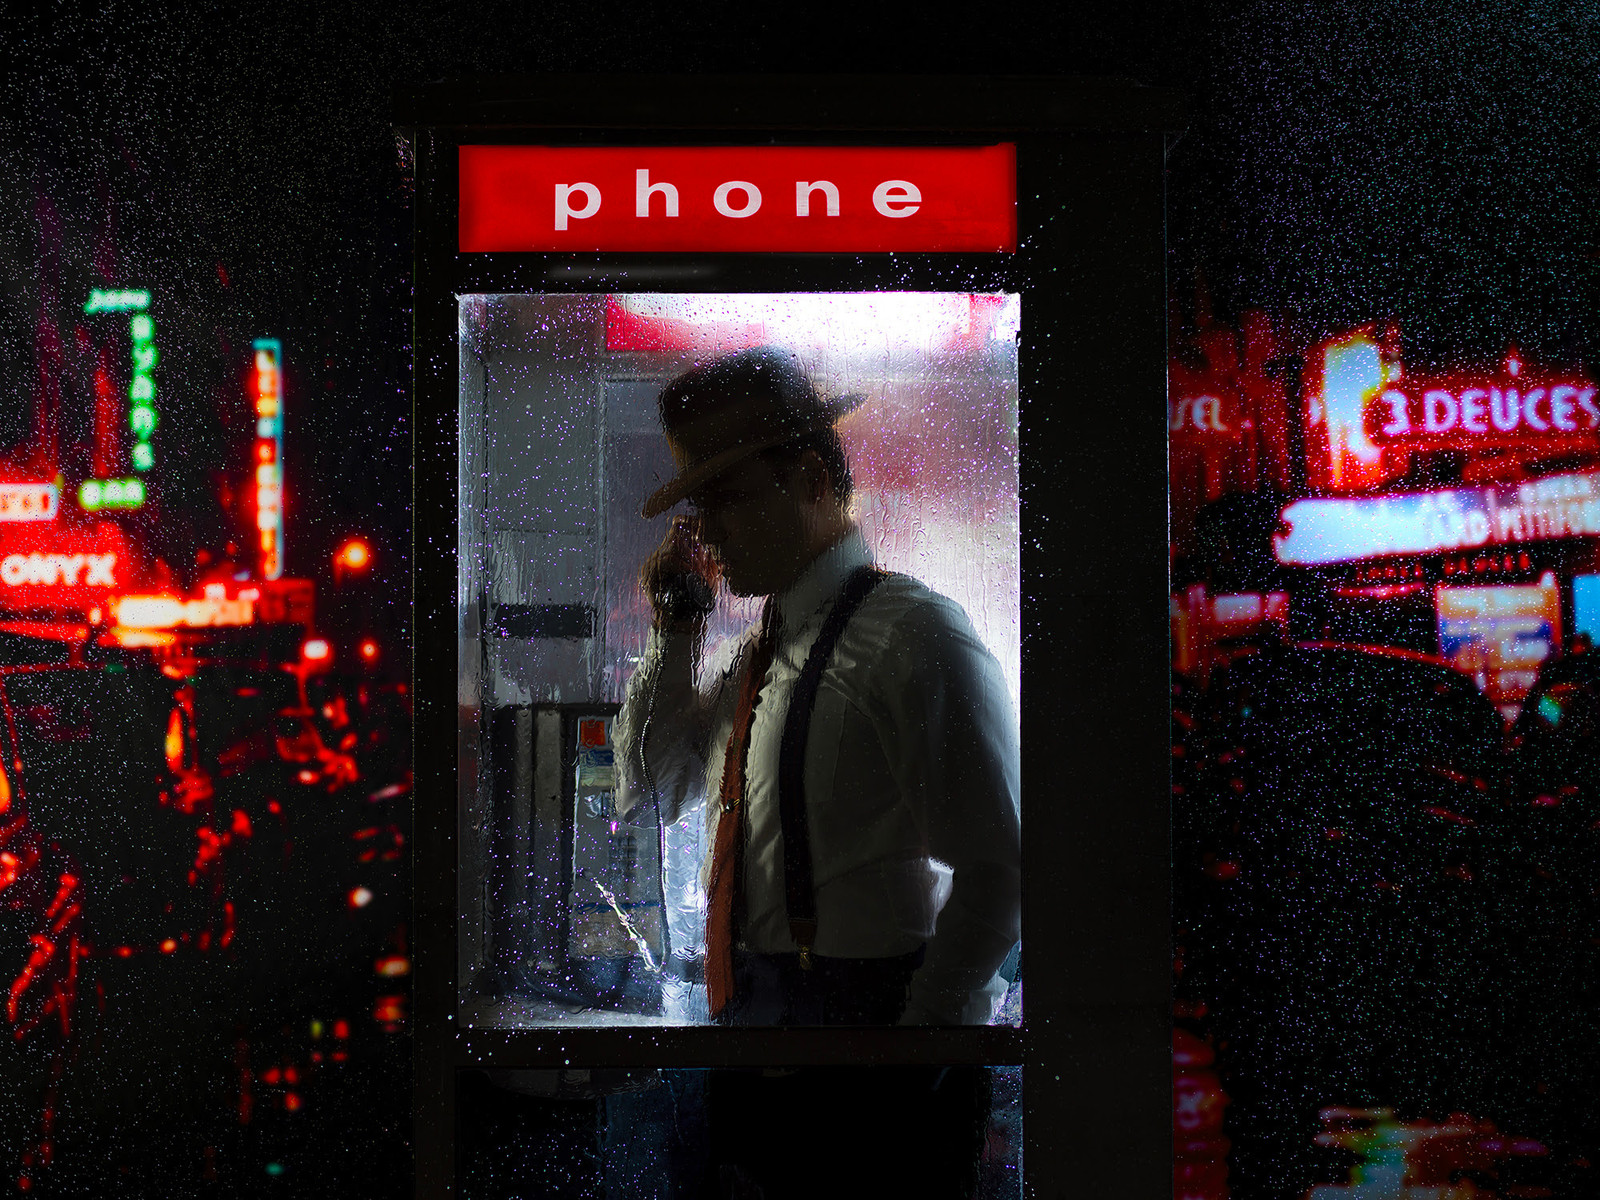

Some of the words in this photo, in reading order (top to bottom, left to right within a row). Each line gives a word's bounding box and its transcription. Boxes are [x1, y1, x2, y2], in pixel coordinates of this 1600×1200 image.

[554, 169, 922, 231] phone
[1423, 384, 1600, 433] DEUCES
[0, 552, 118, 587] ONYX
